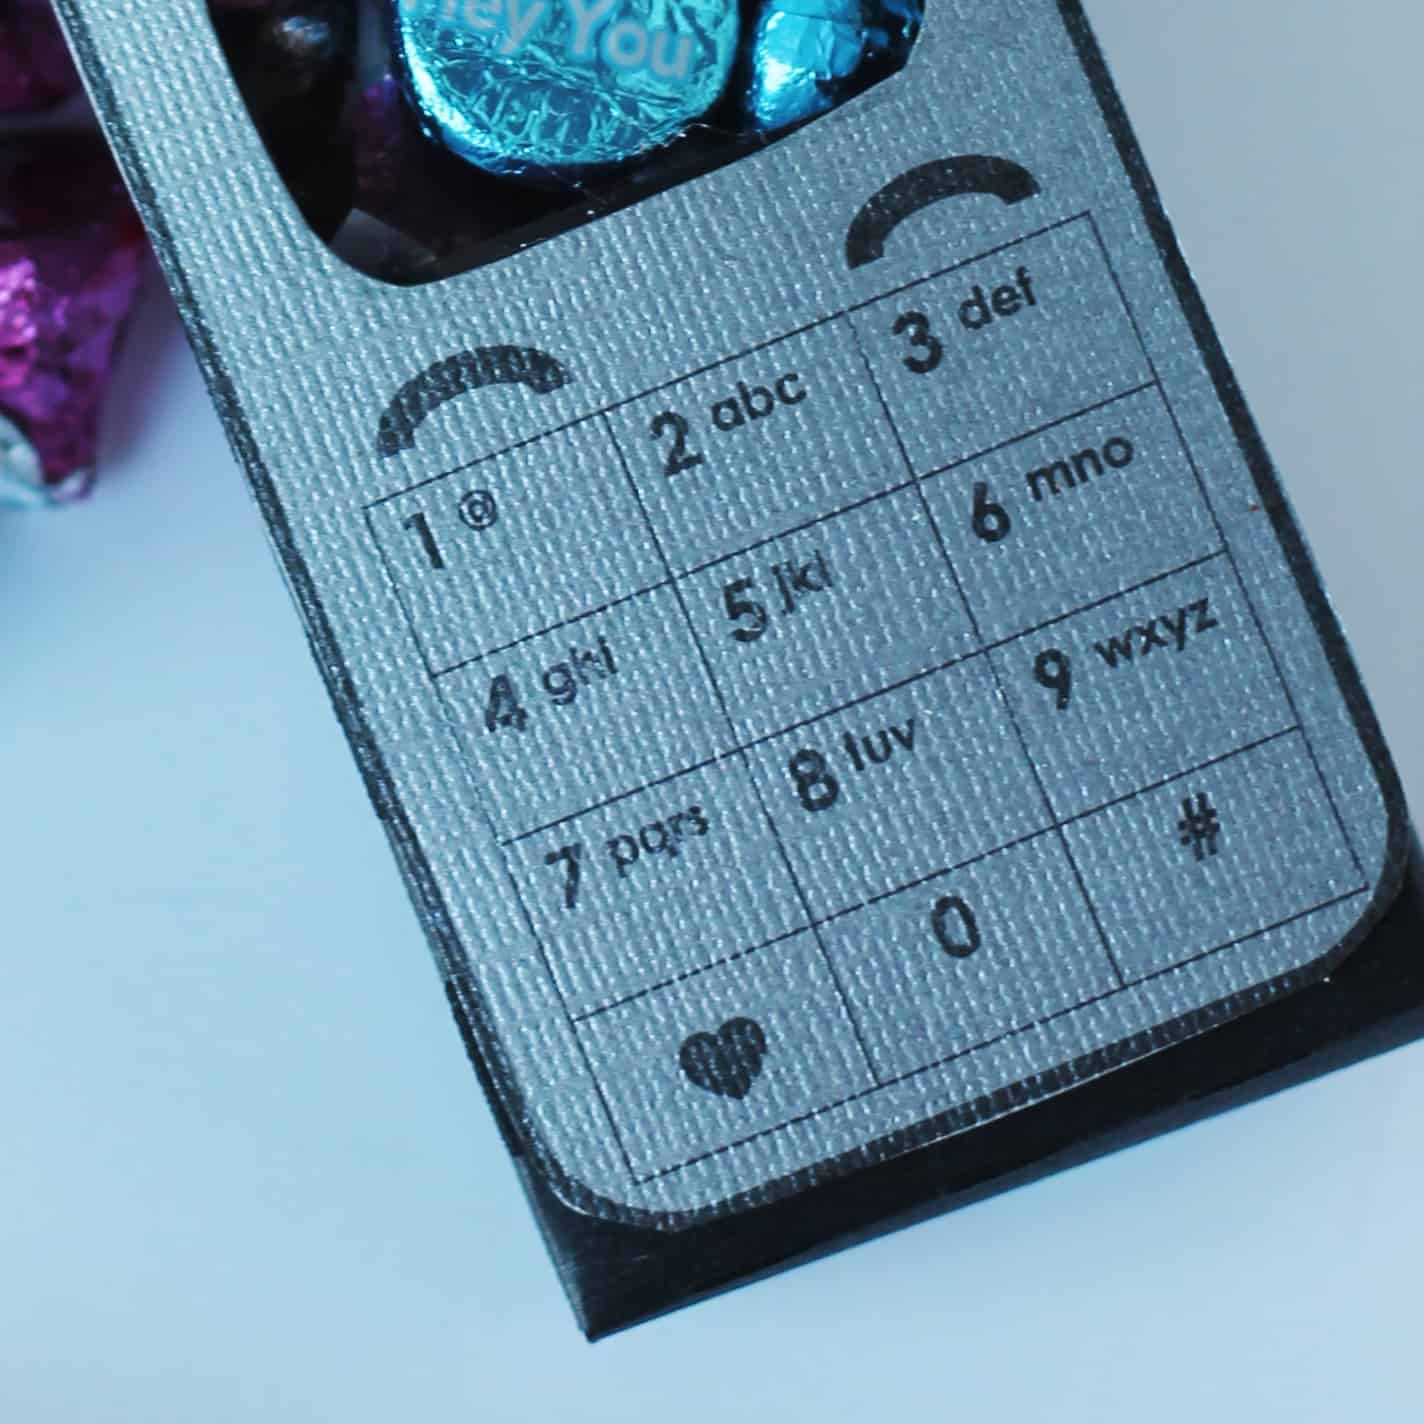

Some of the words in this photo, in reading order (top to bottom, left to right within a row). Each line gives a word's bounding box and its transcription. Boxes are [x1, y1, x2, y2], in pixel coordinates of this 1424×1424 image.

[891, 309, 945, 375] 3
[957, 264, 1037, 331] def
[649, 410, 706, 477] 2
[710, 371, 808, 433] abc
[402, 511, 446, 570] 1
[458, 489, 499, 531] @
[970, 481, 1012, 544] 6
[1025, 435, 1135, 502] mno
[722, 576, 769, 643] 5
[772, 548, 835, 618] jkl
[482, 673, 530, 732] 4
[540, 636, 619, 707] ghi
[1033, 647, 1071, 711] 9
[1093, 597, 1220, 669] wxyz
[787, 749, 840, 813] 8
[841, 718, 916, 773] tuv
[543, 843, 583, 909] 7
[606, 805, 710, 879] pqrs
[1177, 791, 1221, 862] #
[929, 895, 981, 960] 0
